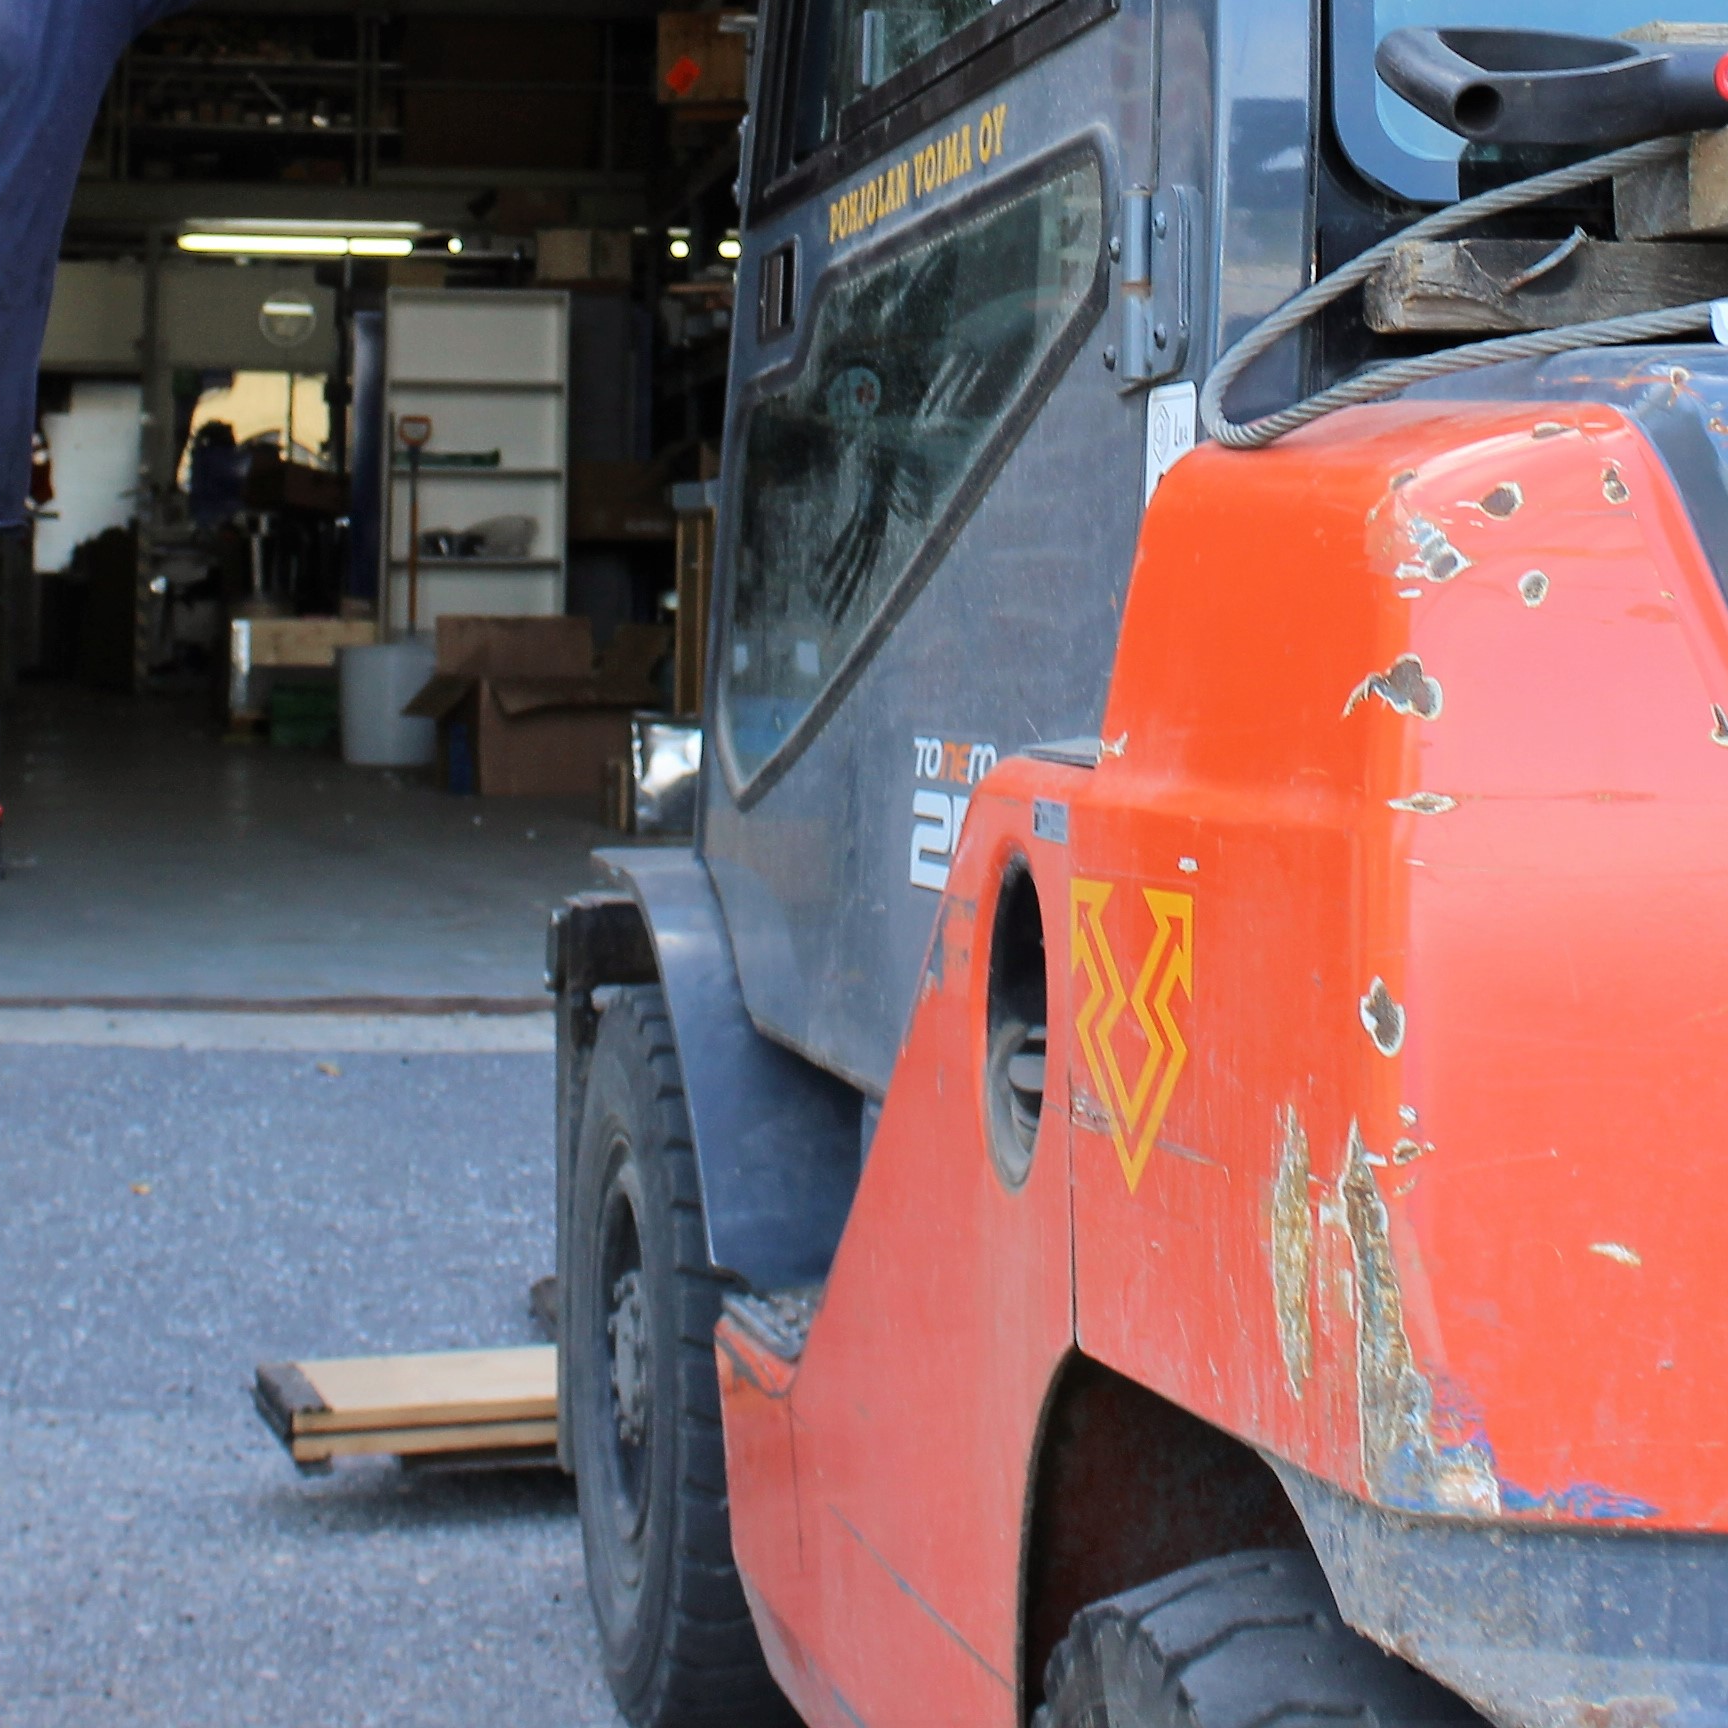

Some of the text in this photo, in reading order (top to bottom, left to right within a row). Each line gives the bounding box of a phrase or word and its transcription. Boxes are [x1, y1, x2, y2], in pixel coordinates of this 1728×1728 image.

[828, 102, 1008, 245] POHJOLAN VOIMA OY
